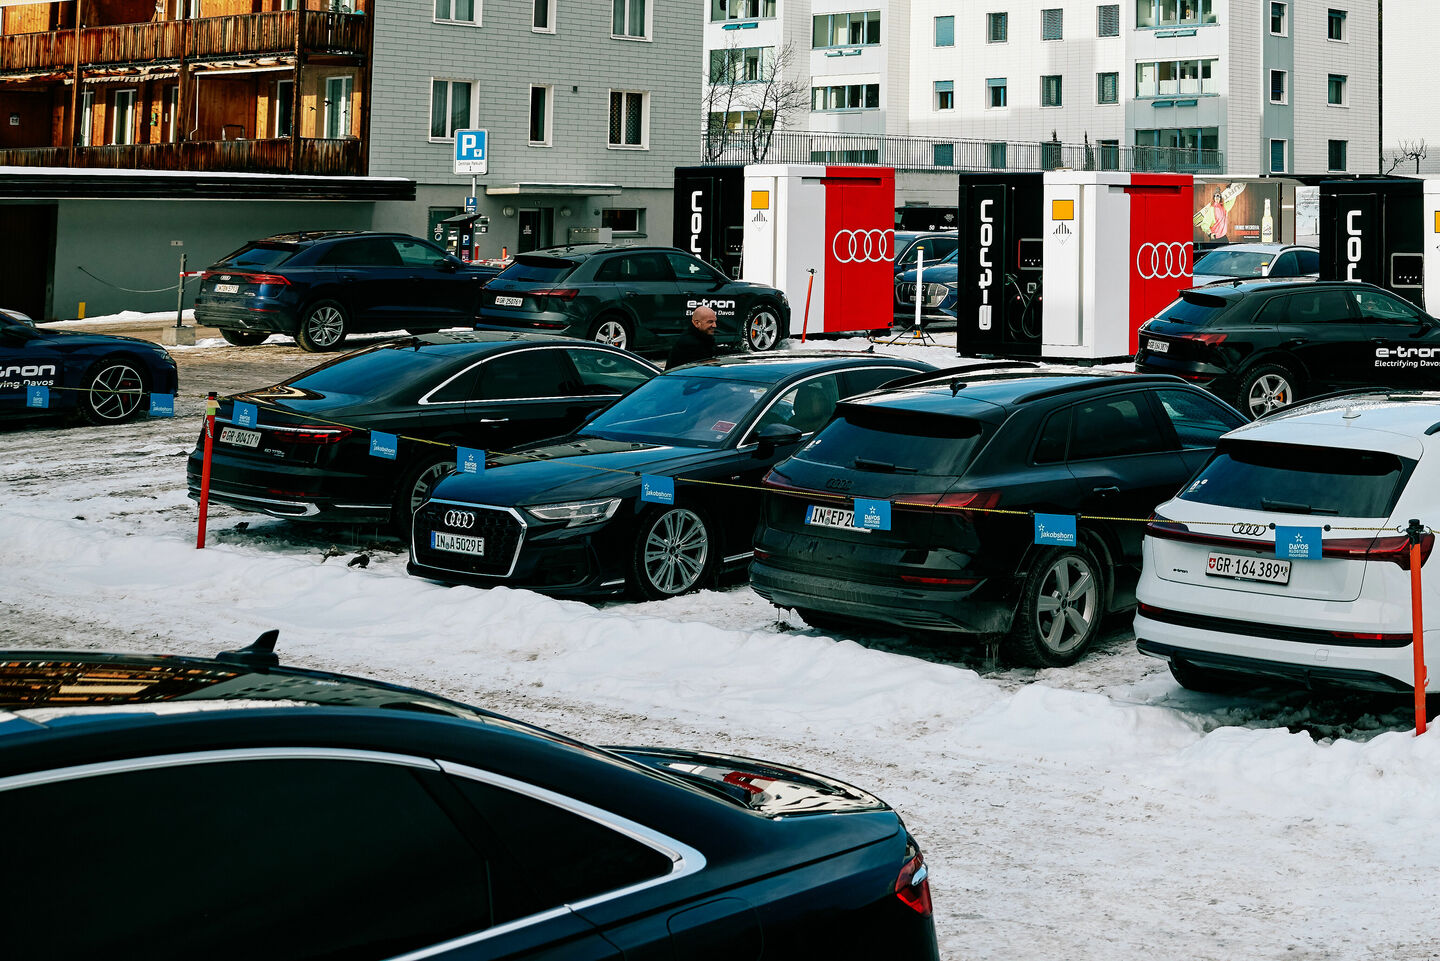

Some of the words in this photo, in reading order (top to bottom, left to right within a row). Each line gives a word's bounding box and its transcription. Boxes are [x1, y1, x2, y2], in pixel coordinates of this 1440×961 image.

[461, 134, 476, 156] P
[691, 191, 703, 253] ron
[463, 235, 469, 243] P
[1347, 209, 1362, 283] ron
[978, 199, 993, 331] e-tron
[687, 299, 735, 308] e-tron
[1374, 360, 1418, 368] Electrifying
[23, 379, 54, 387] Davos
[1040, 530, 1074, 539] jakobshorn
